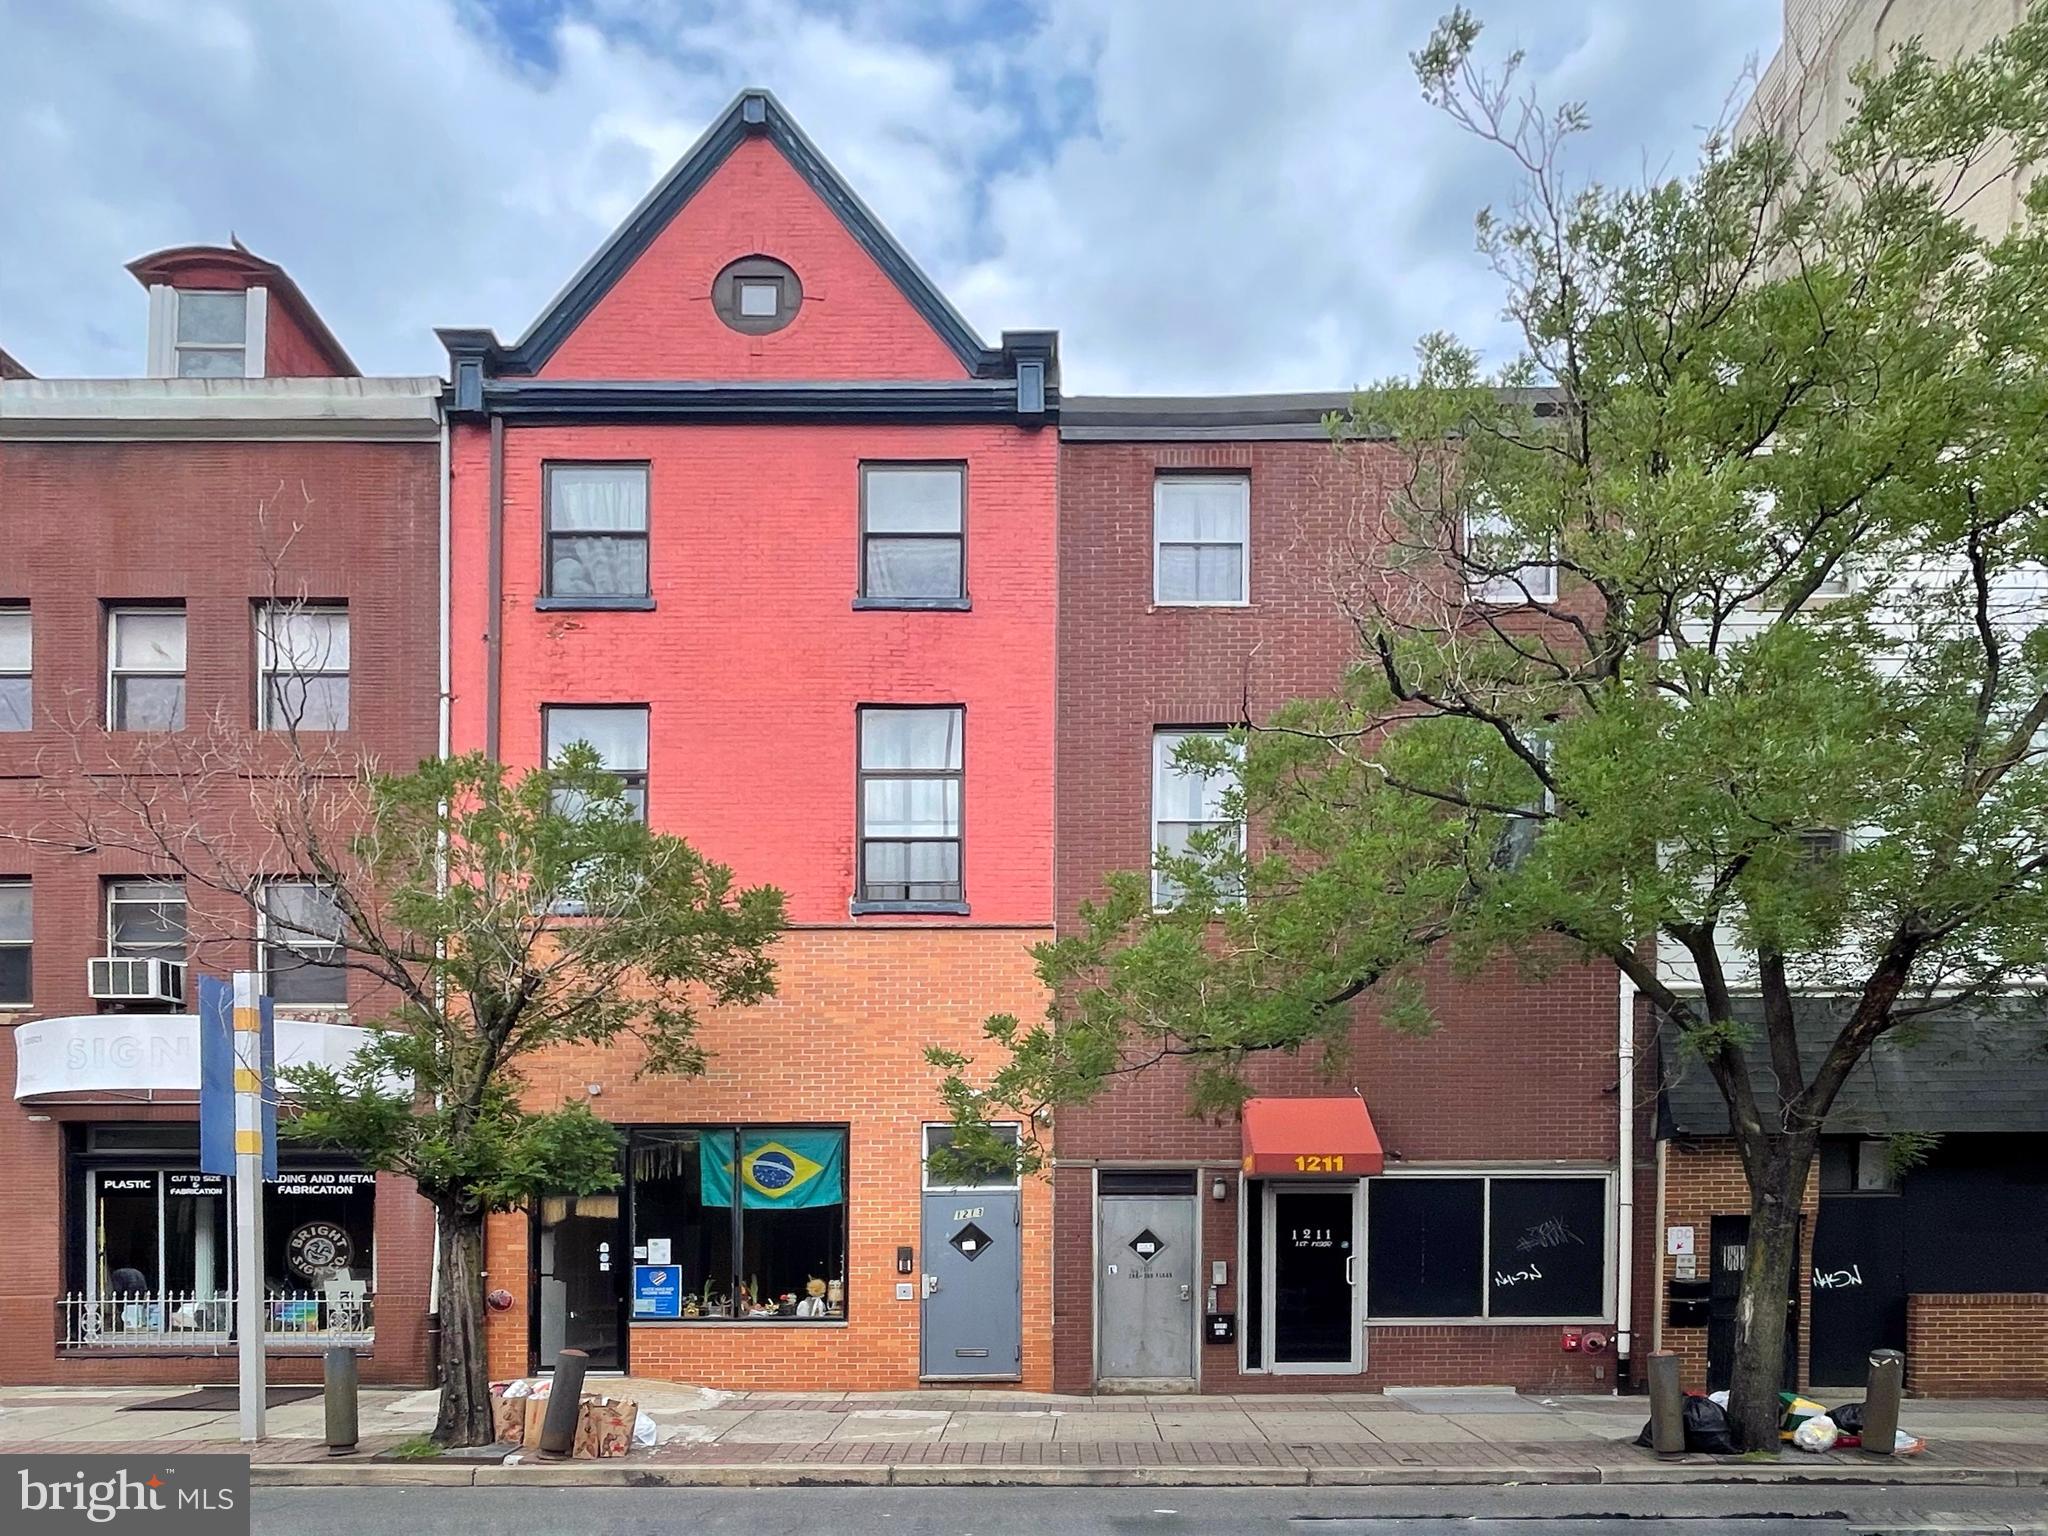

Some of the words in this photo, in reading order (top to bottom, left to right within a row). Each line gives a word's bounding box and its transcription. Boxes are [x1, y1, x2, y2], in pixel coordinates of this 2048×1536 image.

[1295, 1155, 1344, 1172] 1211
[262, 1174, 306, 1183] DING
[309, 1174, 335, 1183] AND
[338, 1174, 376, 1183] METAL
[104, 1180, 151, 1189] PLASTIC
[278, 1185, 353, 1194] FABRICATION
[957, 1208, 983, 1219] 1213
[291, 1226, 347, 1249] BRIGHT
[1292, 1228, 1331, 1240] 1211
[292, 1255, 324, 1276] SIGN
